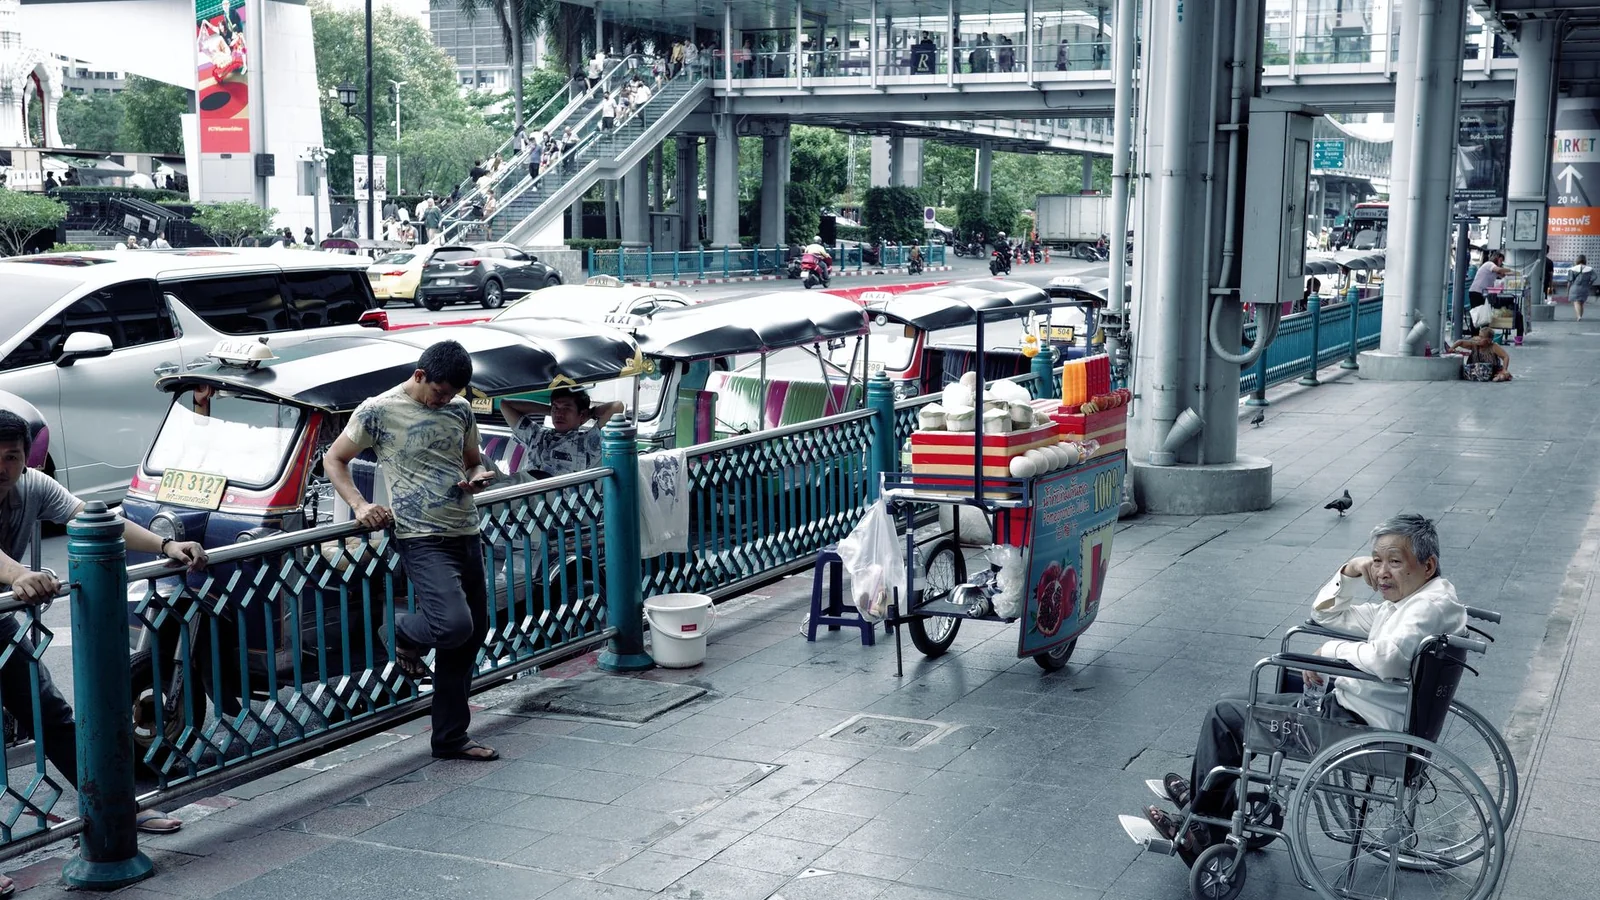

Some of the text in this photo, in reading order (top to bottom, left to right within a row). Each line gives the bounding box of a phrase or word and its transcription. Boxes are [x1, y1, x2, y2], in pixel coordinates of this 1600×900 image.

[1557, 196, 1568, 204] 20
[594, 277, 608, 285] TAXI
[604, 314, 631, 325] TAXI
[219, 341, 254, 355] TAXI
[187, 474, 224, 495] 3127
[1270, 719, 1304, 736] BST
